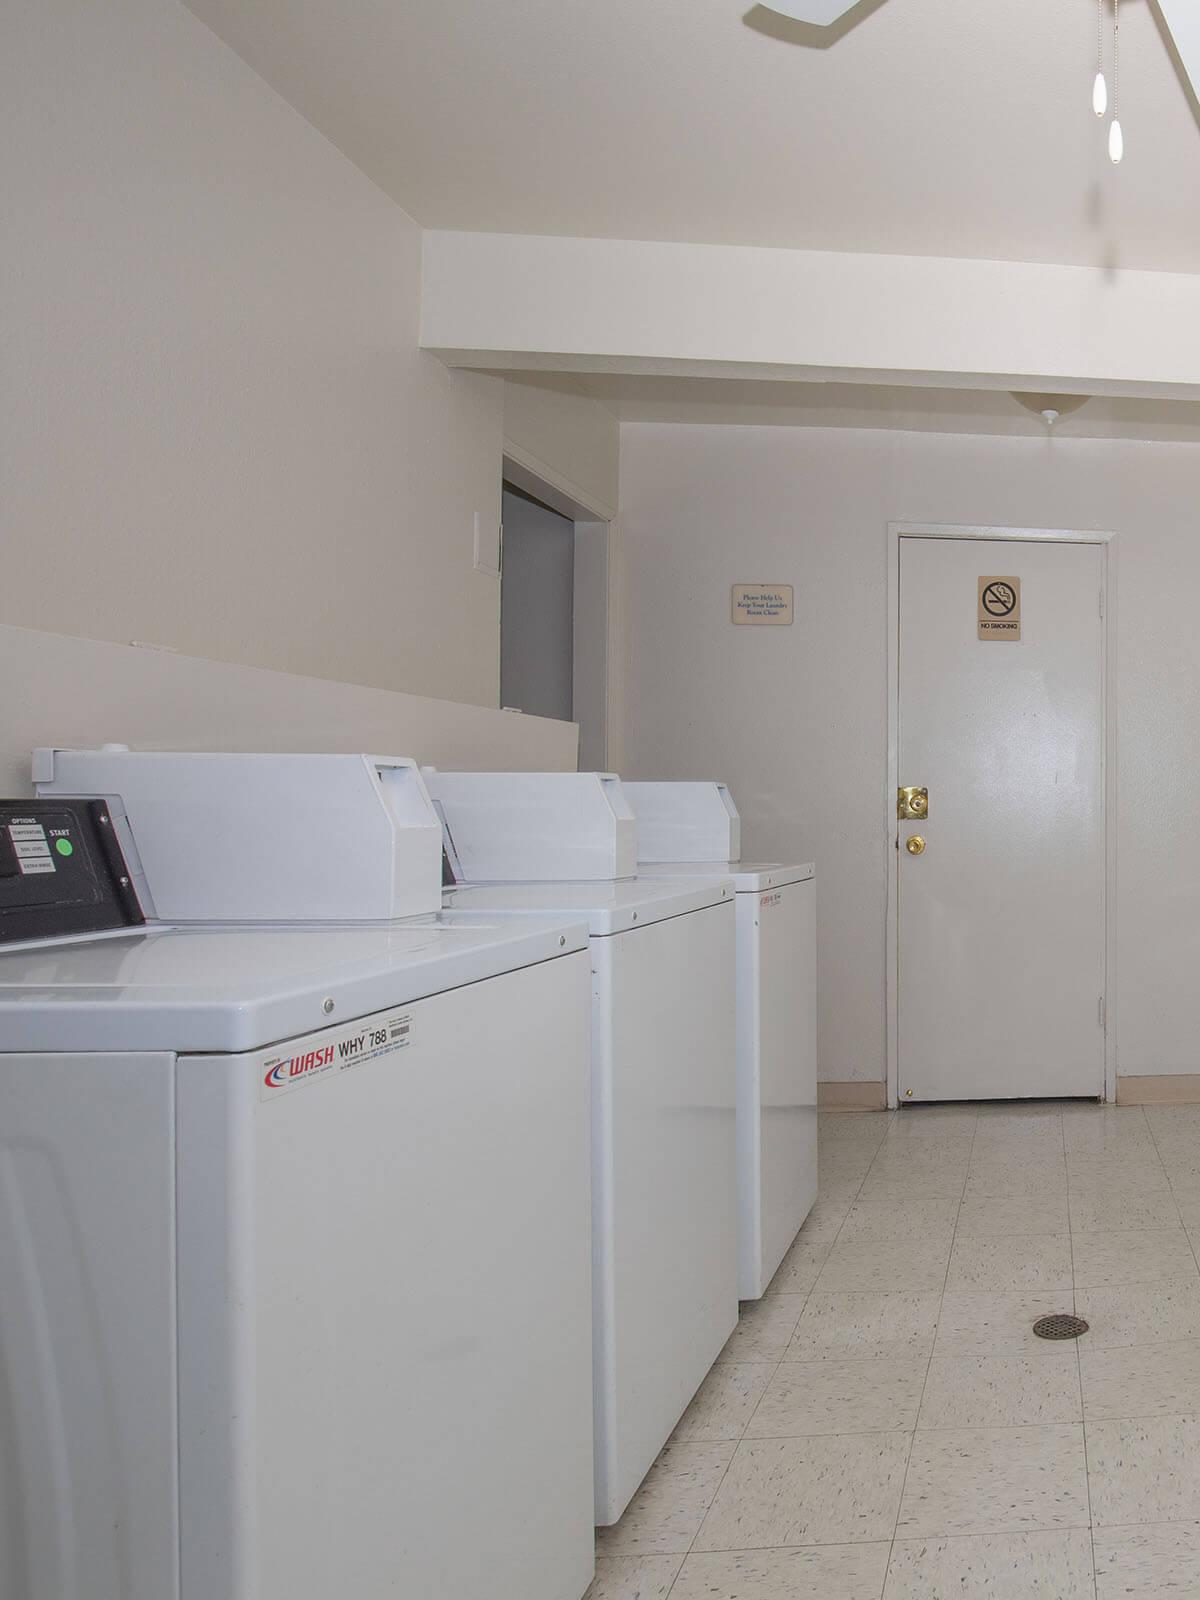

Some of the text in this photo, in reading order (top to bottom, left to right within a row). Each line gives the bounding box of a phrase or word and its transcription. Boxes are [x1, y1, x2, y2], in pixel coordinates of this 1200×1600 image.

[760, 594, 773, 602] Help
[49, 829, 70, 837] START
[289, 1045, 335, 1077] WASH
[338, 1036, 365, 1057] WHY
[369, 1029, 387, 1047] 788
